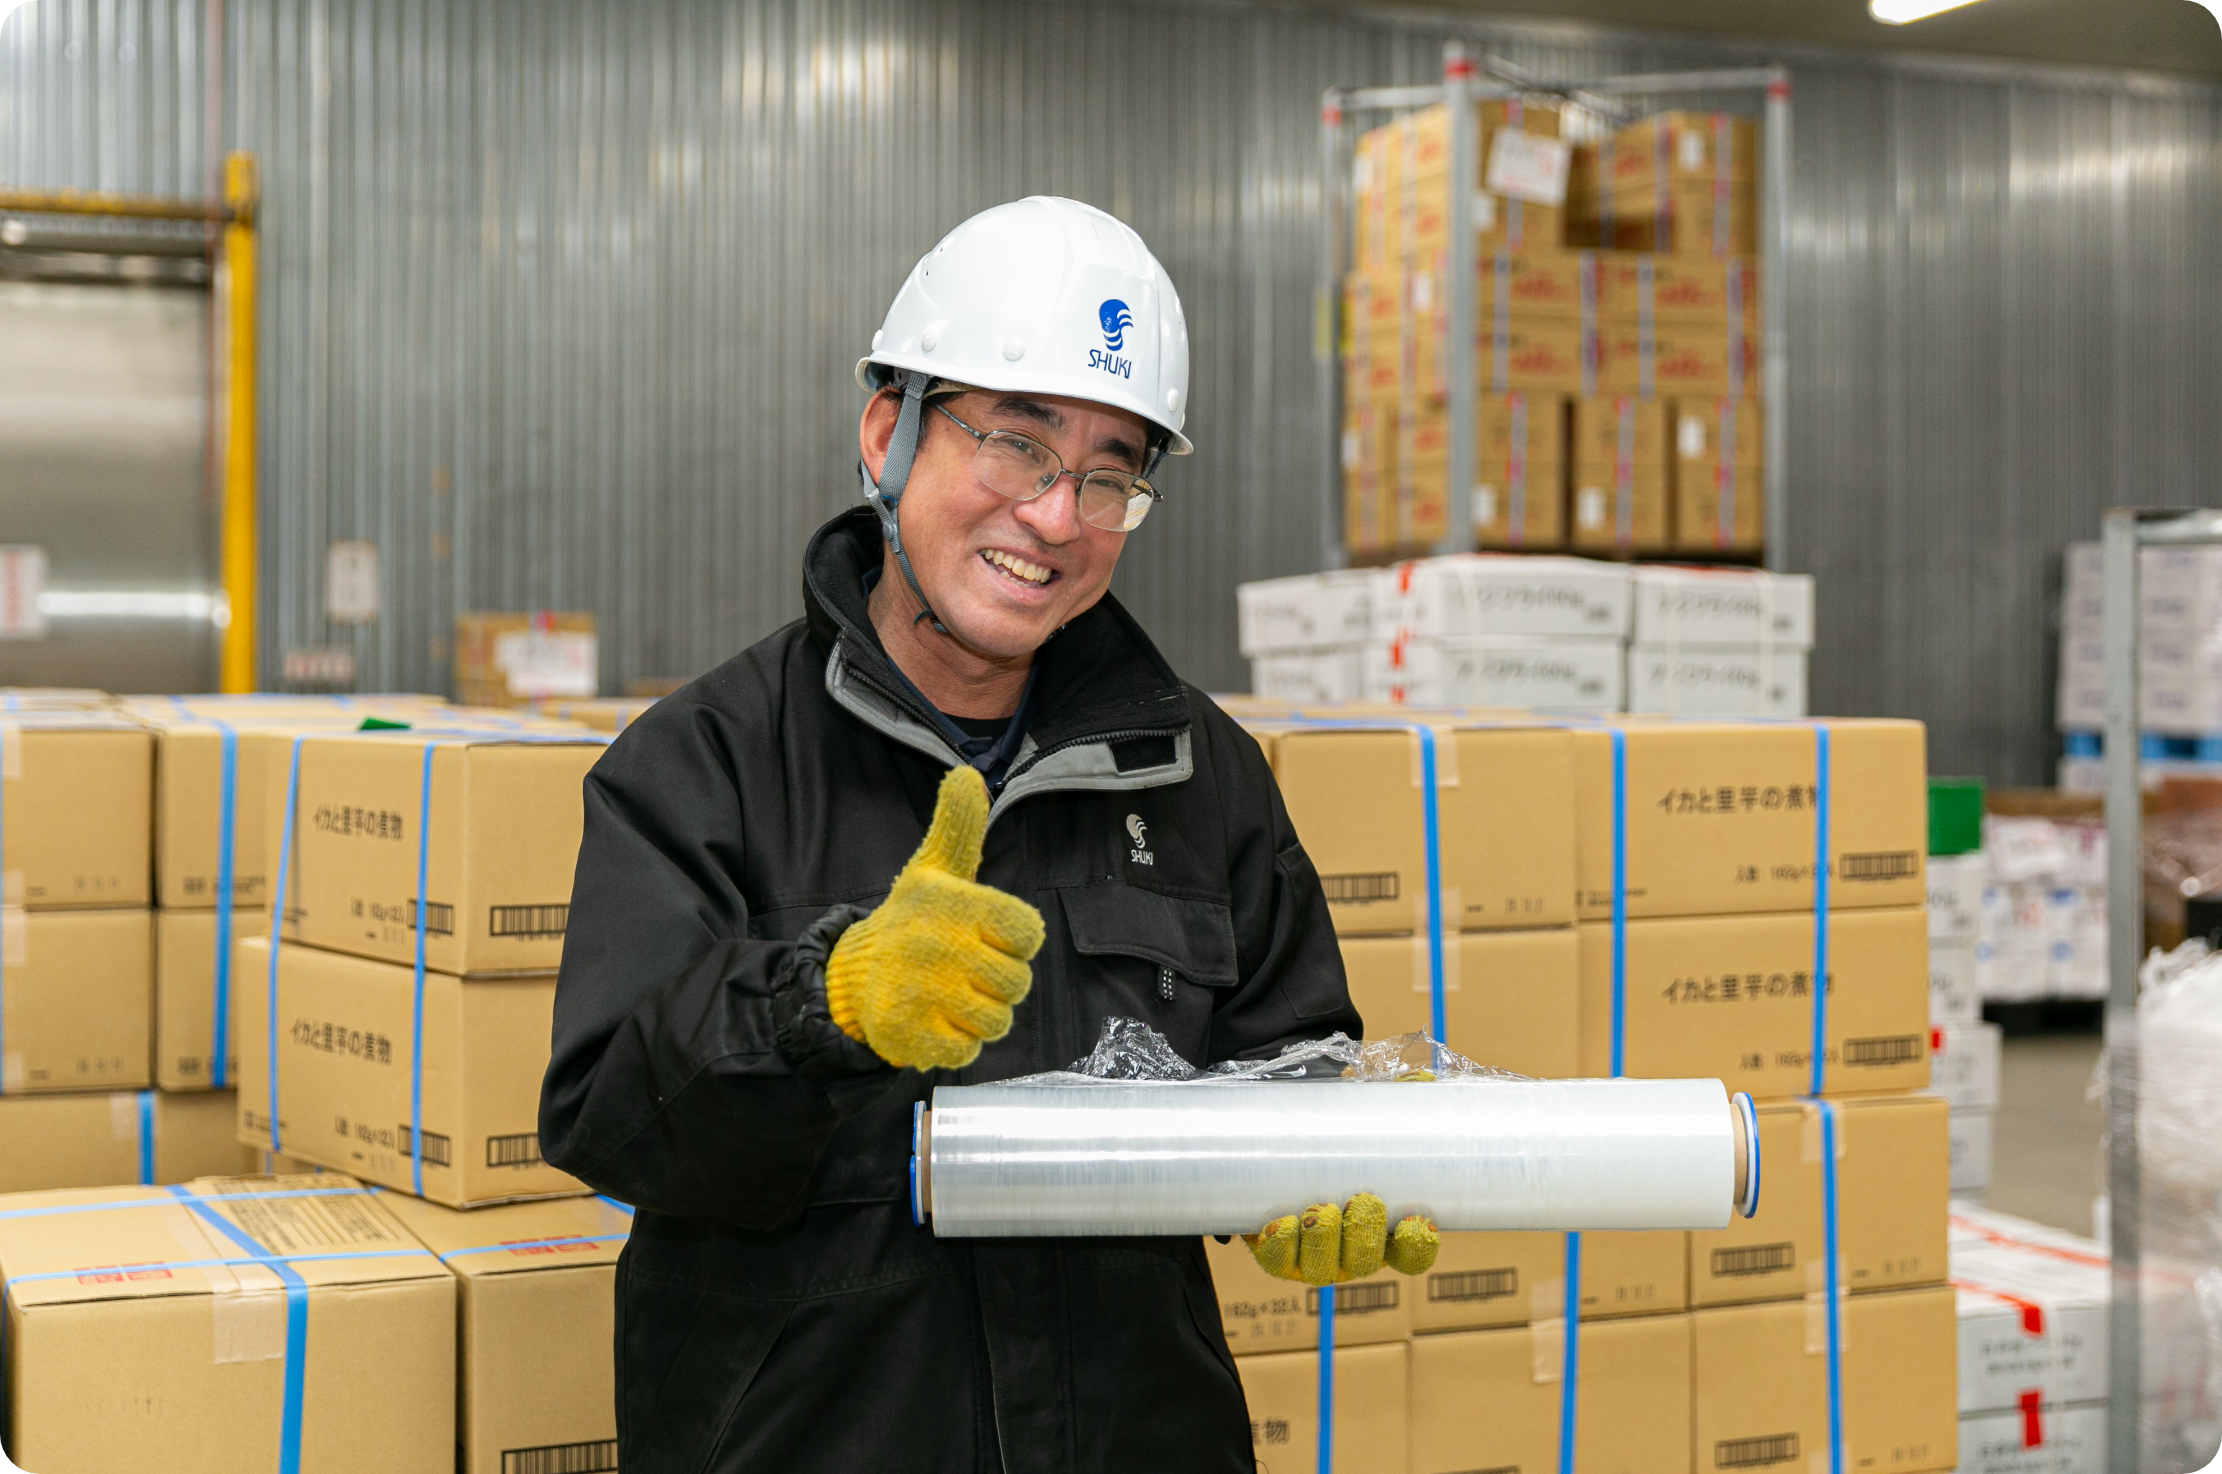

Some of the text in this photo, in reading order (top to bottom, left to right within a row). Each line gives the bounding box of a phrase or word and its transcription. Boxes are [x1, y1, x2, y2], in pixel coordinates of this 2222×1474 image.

[1087, 348, 1132, 380] SHUKI
[313, 805, 403, 841] イカと里芋の煮物
[1130, 849, 1154, 866] SHUKI
[290, 1019, 391, 1065] イカと里芋の煮物
